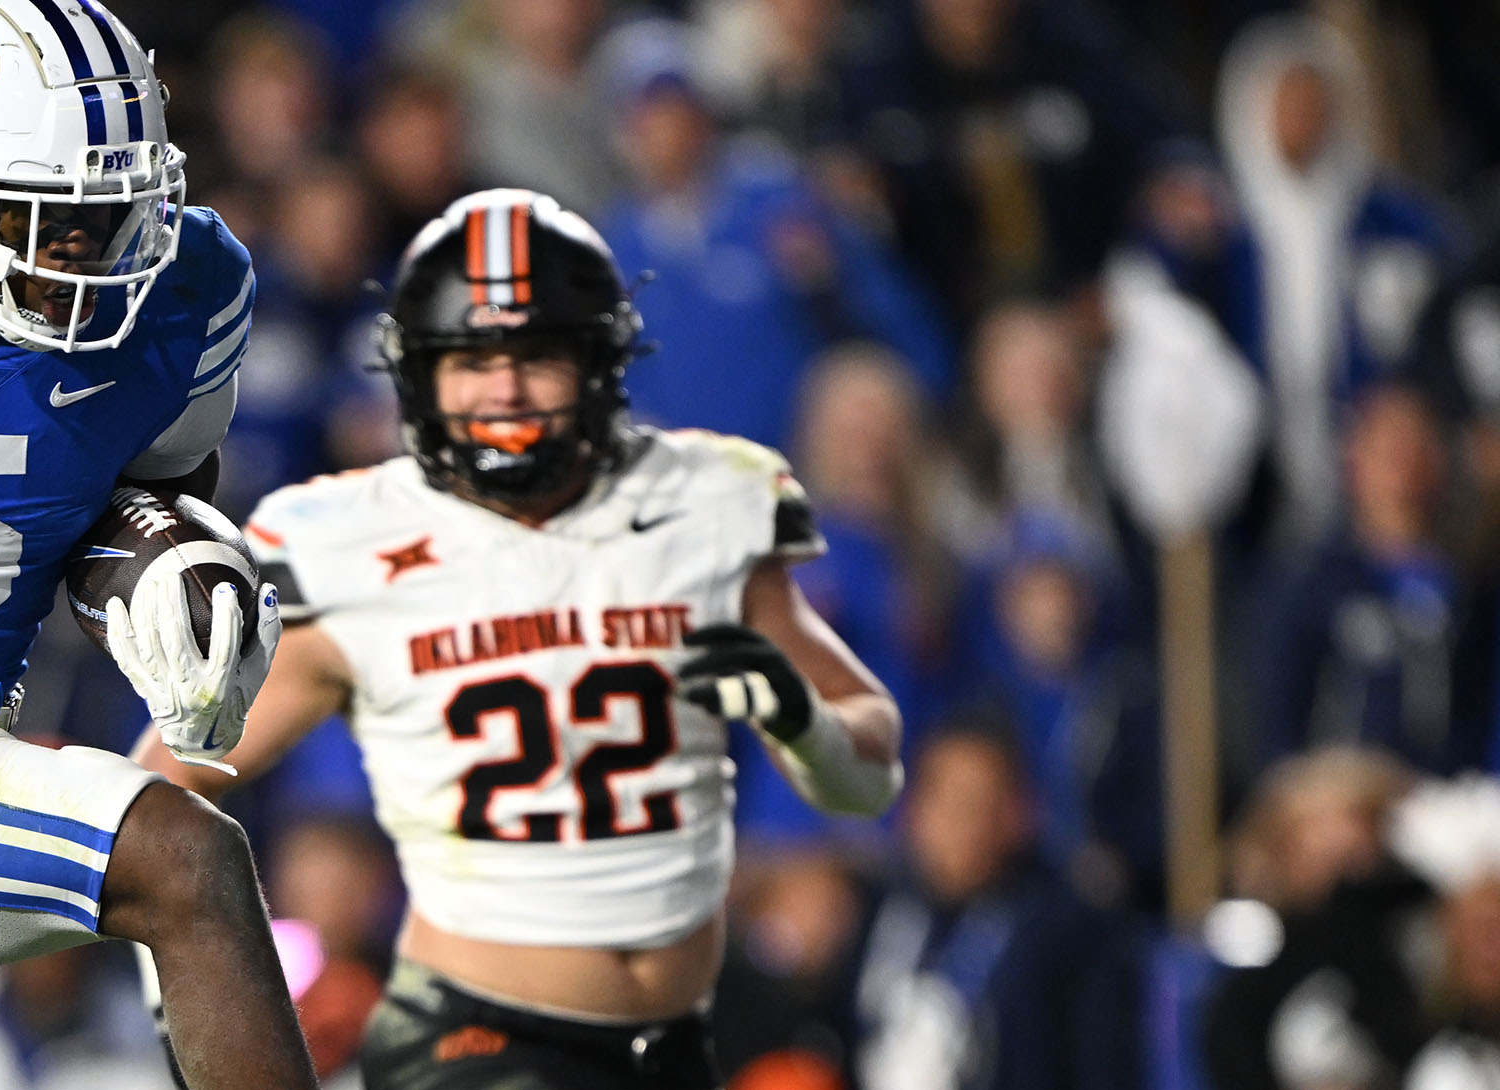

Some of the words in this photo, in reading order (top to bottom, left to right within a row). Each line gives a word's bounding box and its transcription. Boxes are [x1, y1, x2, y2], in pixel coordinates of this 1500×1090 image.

[103, 150, 134, 170] BYU
[409, 607, 585, 674] OKLAHOMA
[445, 660, 682, 843] 22
